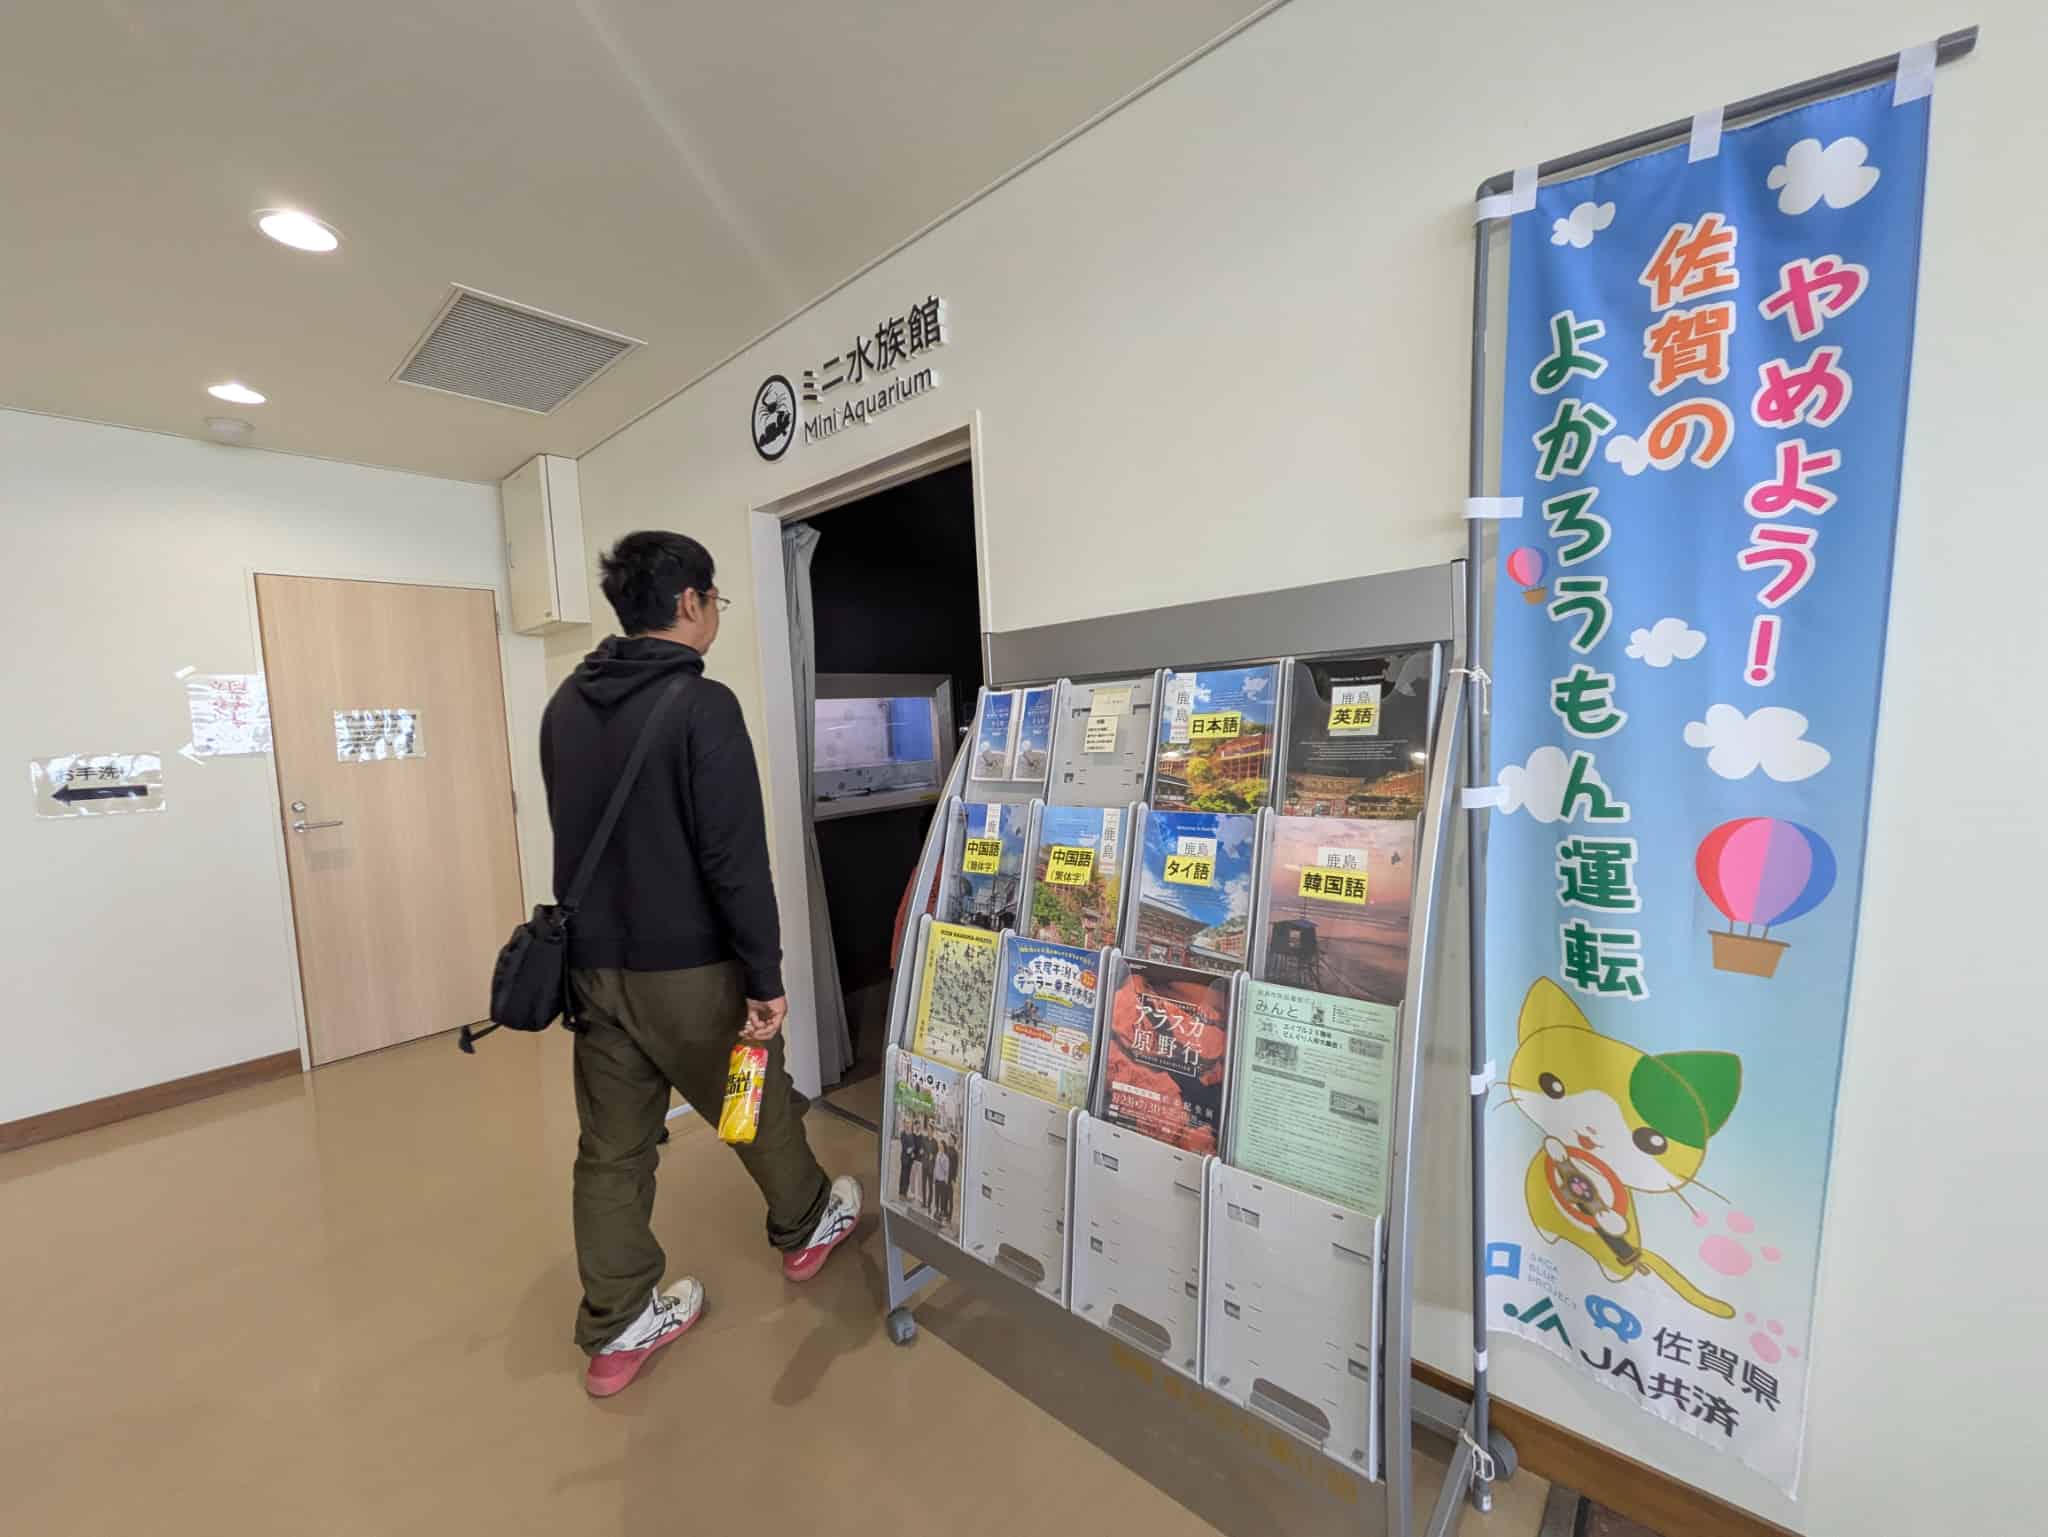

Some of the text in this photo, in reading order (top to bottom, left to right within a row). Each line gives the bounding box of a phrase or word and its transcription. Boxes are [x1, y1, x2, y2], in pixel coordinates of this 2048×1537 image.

[803, 295, 942, 400] ミニ水族館
[1640, 215, 1737, 468] 佐賀の
[804, 367, 933, 443] Mini Aquarium
[1740, 257, 1866, 685] やめよう！
[1532, 311, 1647, 998] よかろうもん運転
[1192, 716, 1240, 734] 日本語
[1332, 707, 1374, 725] 英語
[967, 840, 1001, 857] 中国語
[1053, 850, 1092, 867] 中国語
[1167, 861, 1210, 880] タイ語
[1303, 873, 1366, 899] 韓国語
[1135, 1004, 1205, 1038] アラスカ
[1255, 1000, 1299, 1019] みんと
[1132, 1028, 1204, 1066] 原野行
[1653, 1326, 1781, 1412] 佐賀県
[1580, 1346, 1740, 1438] JA共済
